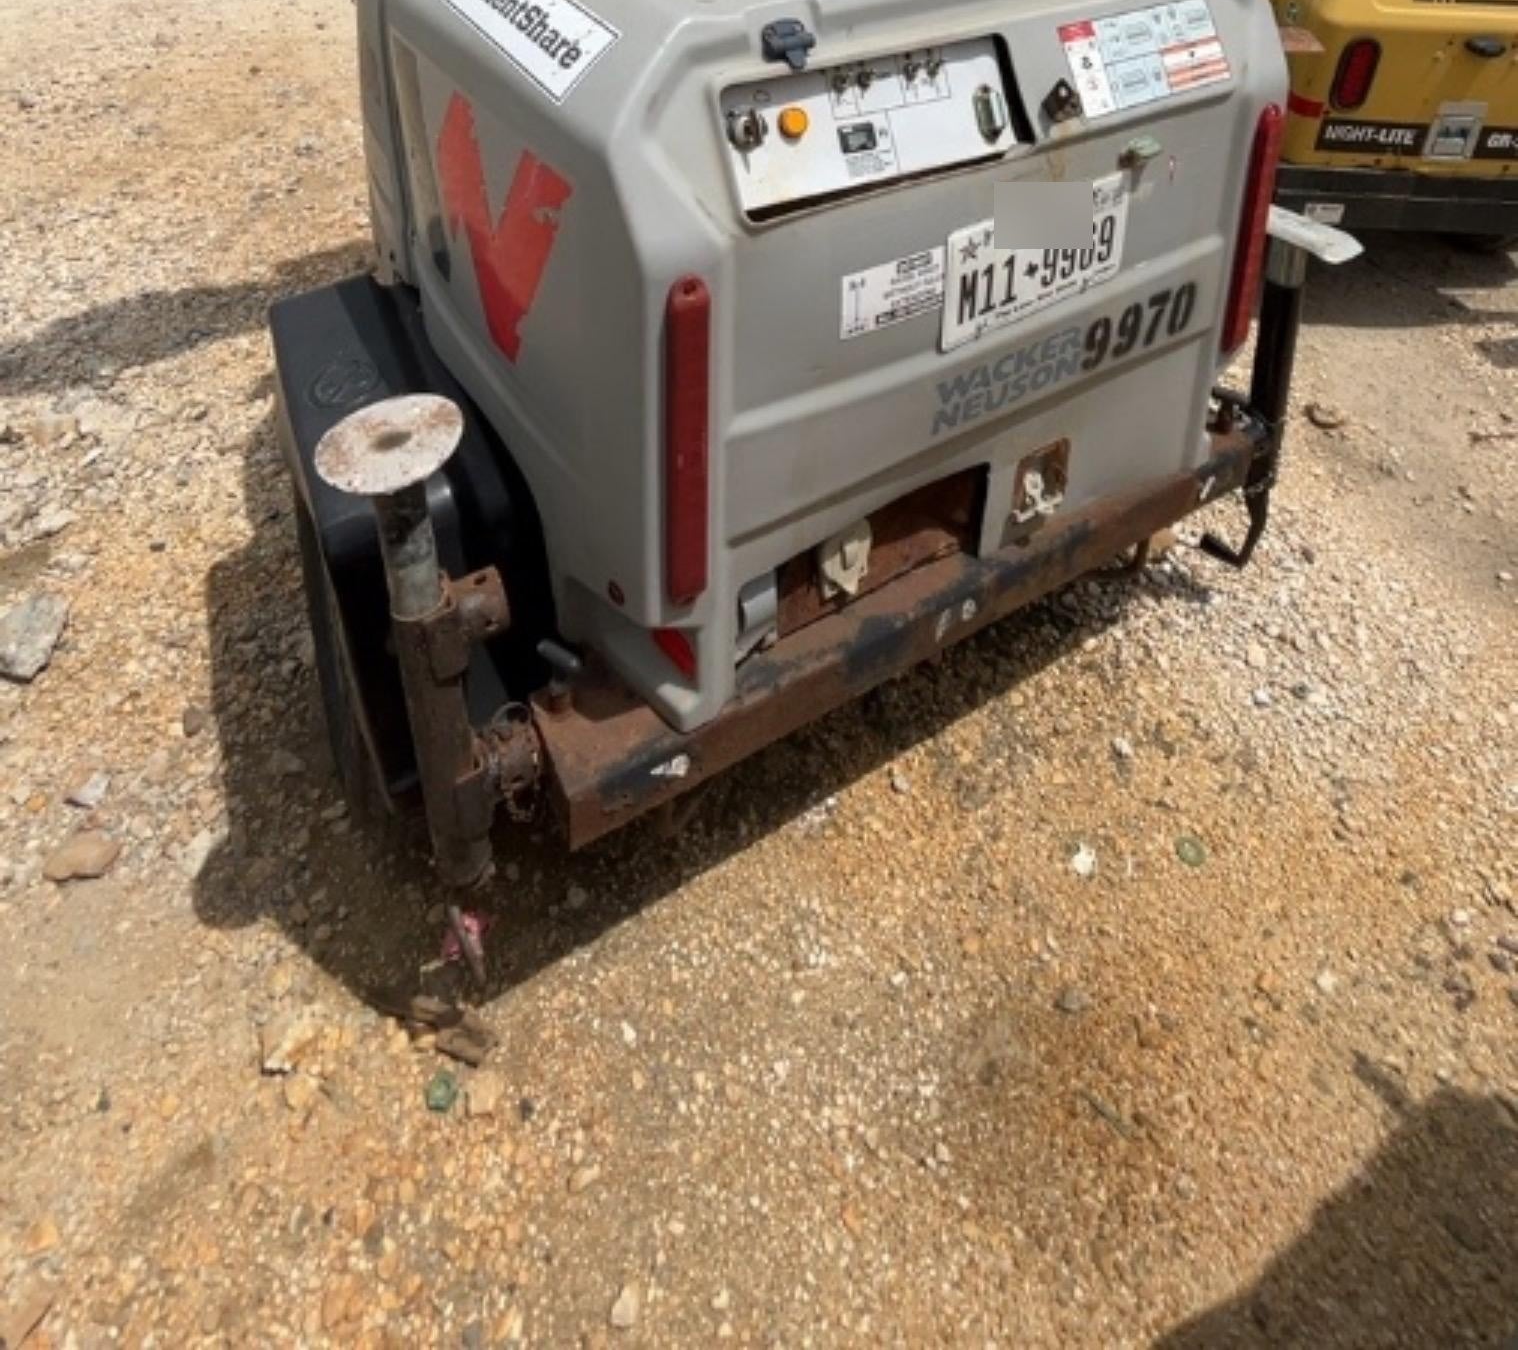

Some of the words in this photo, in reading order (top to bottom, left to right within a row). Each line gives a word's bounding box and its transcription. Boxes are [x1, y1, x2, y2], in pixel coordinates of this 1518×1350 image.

[1324, 124, 1418, 147] NIGHT-LITE
[937, 326, 1082, 404] WACKER
[1081, 280, 1199, 370] 9970
[930, 354, 1082, 436] NEUSON
